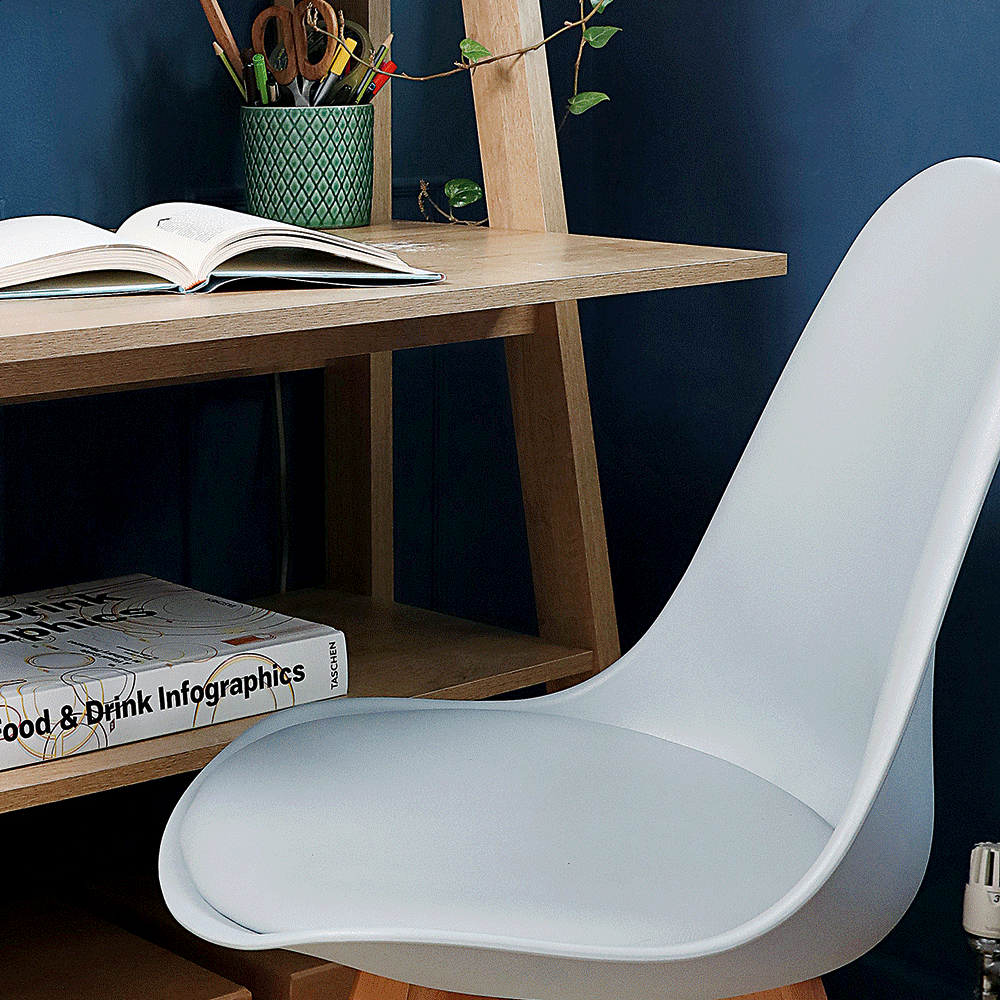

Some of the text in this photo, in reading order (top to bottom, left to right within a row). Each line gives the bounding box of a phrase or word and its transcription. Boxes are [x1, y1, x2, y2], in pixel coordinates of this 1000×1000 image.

[328, 641, 338, 690] TASCHEN
[60, 705, 78, 731] &
[85, 689, 154, 725] Drink
[158, 664, 306, 710] Infographics
